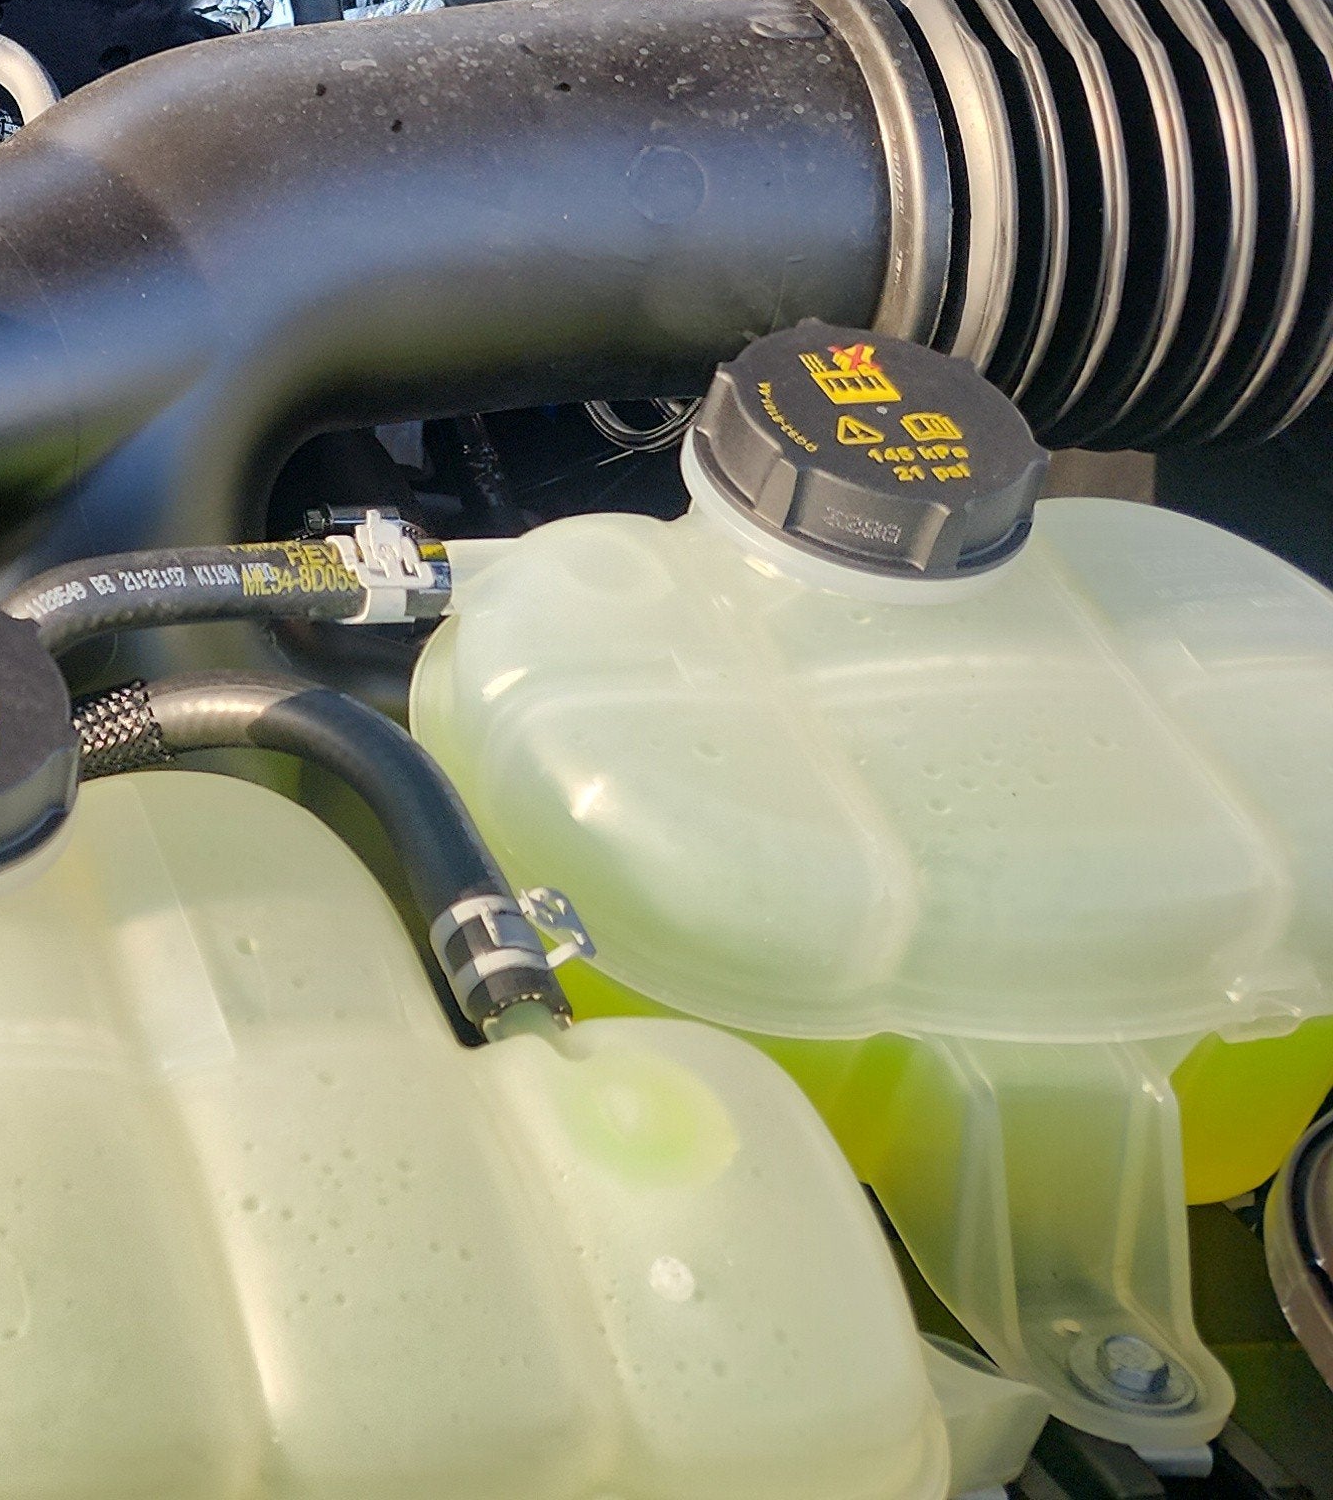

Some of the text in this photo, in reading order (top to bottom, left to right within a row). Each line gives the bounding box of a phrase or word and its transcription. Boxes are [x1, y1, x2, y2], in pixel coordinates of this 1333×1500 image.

[868, 443, 969, 464] 145 kPa
[893, 461, 971, 483] 21 psi
